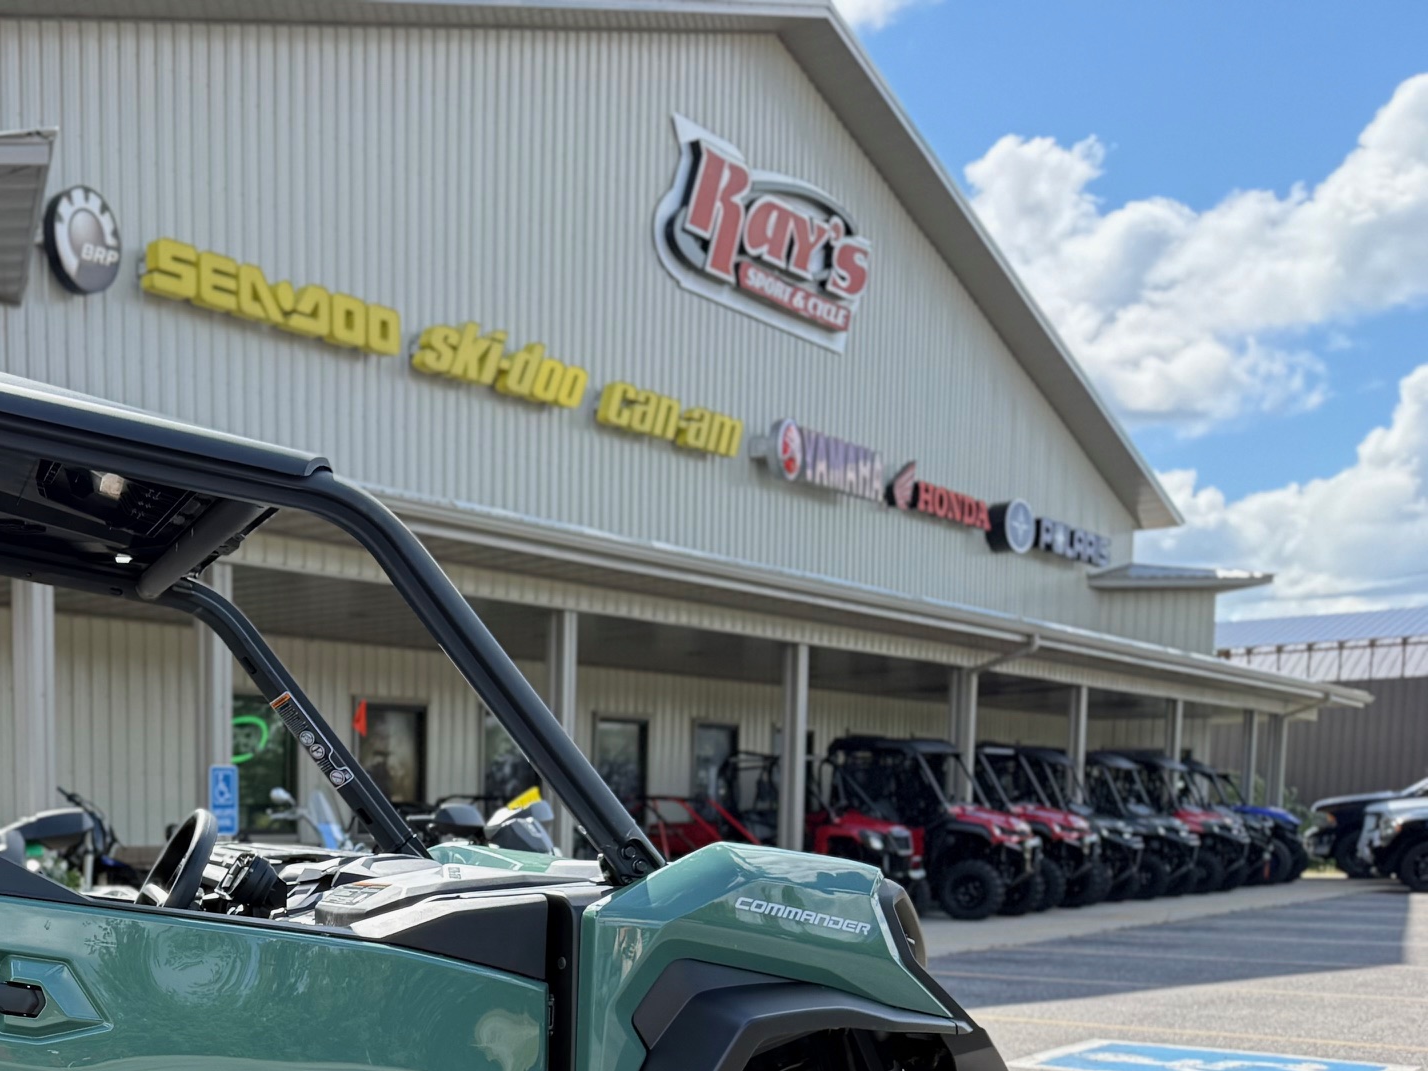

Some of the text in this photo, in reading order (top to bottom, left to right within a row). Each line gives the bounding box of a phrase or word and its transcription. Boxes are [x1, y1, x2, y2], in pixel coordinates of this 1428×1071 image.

[81, 243, 119, 266] BRP
[746, 267, 848, 327] SPORT & CYCLE
[803, 427, 883, 502] YAMAHA
[918, 480, 992, 532] HONDA
[735, 897, 871, 935] COMMANDER
